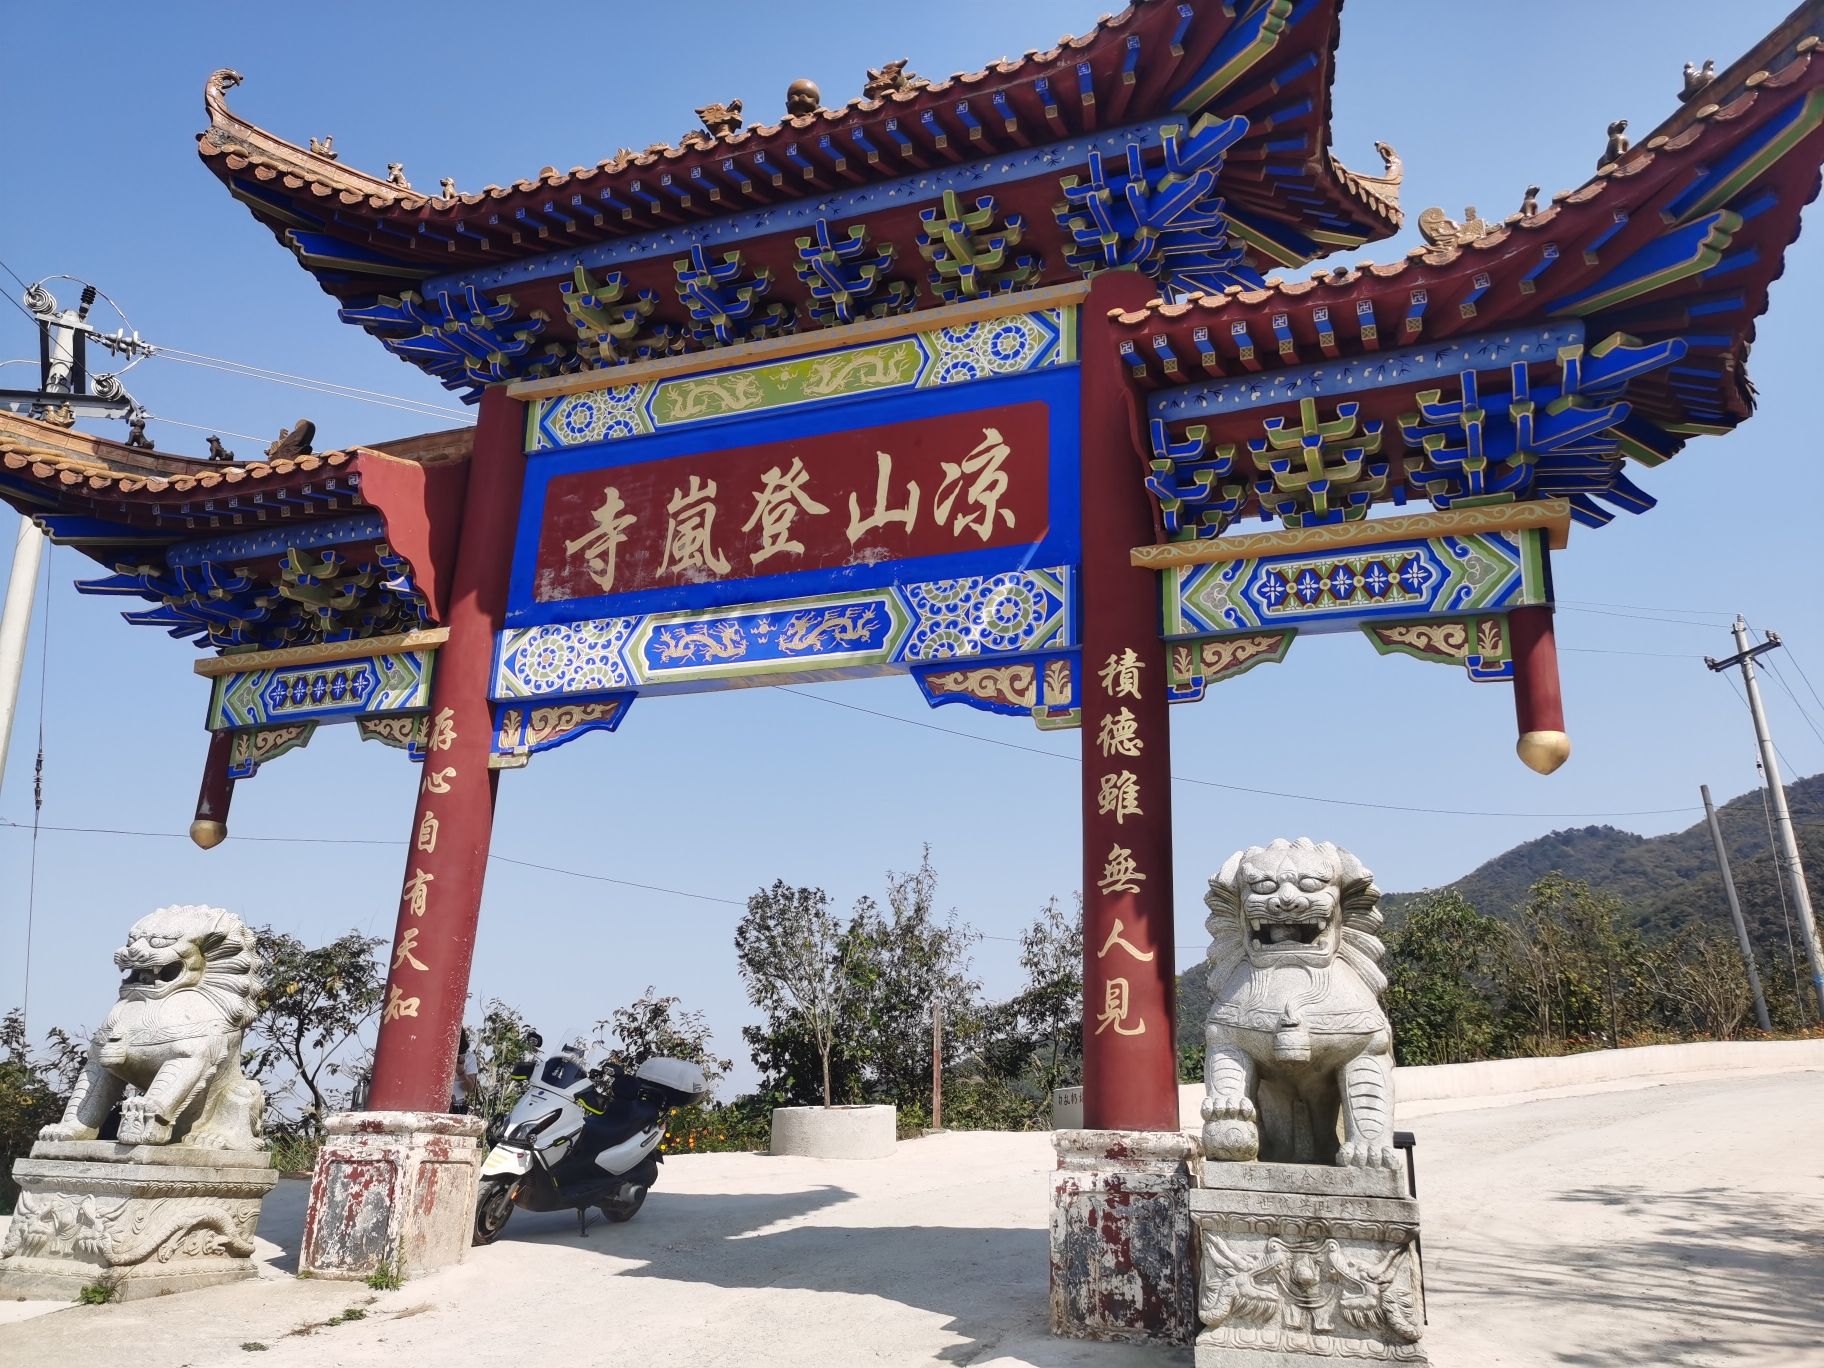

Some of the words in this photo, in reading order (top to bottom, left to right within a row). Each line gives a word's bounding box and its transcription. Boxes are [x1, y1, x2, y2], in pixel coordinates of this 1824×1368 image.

[383, 706, 458, 1025] 存心自有天知
